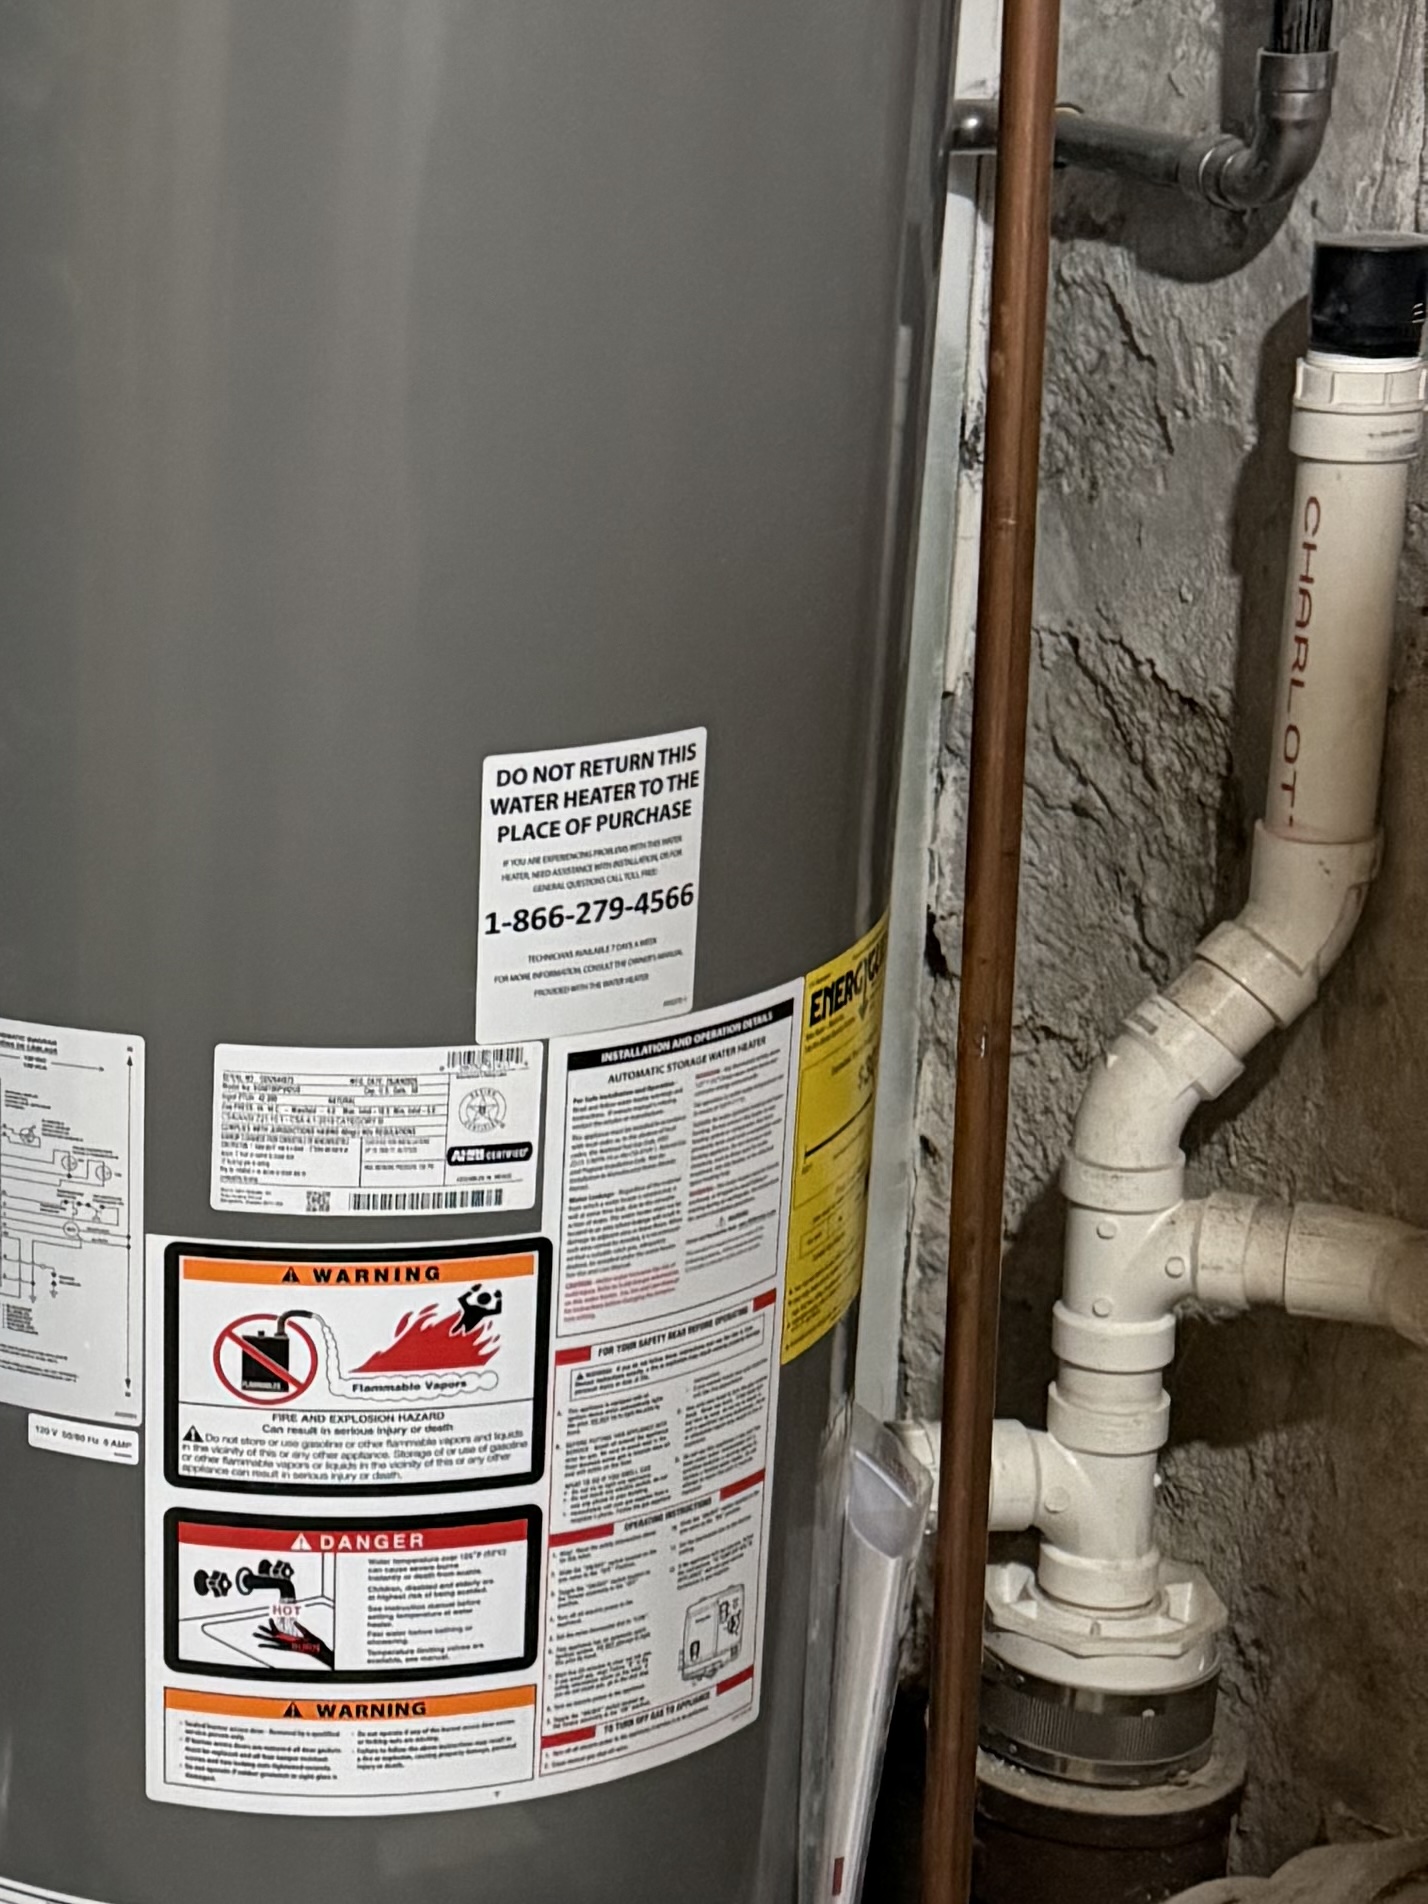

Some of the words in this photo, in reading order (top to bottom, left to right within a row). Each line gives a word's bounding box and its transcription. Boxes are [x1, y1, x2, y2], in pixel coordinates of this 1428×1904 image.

[1279, 495, 1322, 828] CHARLOT
[496, 766, 527, 788] DO
[532, 762, 574, 784] NOT
[579, 750, 654, 778] RETURN
[657, 742, 696, 765] THIS
[489, 789, 558, 818] WATER
[563, 781, 636, 808] HEATER
[638, 777, 663, 796] TO
[666, 770, 699, 792] THE
[497, 817, 560, 845] PLACE
[565, 815, 591, 836] OF
[596, 799, 691, 831] PURCHASE
[484, 882, 694, 938] 1-866-279-4566
[601, 1039, 670, 1063] INSTALLATION
[672, 1037, 692, 1051] AND
[694, 1021, 741, 1045] OPERATION
[608, 1065, 664, 1084] AUTOMATIC
[667, 1055, 707, 1074] STORAGE
[709, 1046, 736, 1062] WATER
[738, 1036, 766, 1055] HEATER
[314, 1266, 440, 1283] WARNING
[352, 1381, 420, 1393] Flammable
[426, 1379, 467, 1392] Vapors
[262, 1424, 283, 1433] Can
[287, 1426, 318, 1435] result
[321, 1426, 331, 1435] in
[334, 1426, 375, 1435] serious
[378, 1425, 408, 1437] injury
[425, 1422, 453, 1432] death
[273, 1413, 298, 1422] FIRE
[301, 1413, 326, 1422] AND
[330, 1413, 395, 1423] EXPLOSION
[399, 1411, 445, 1422] HAZARD
[321, 1533, 423, 1550] DANGER
[273, 1604, 301, 1616] HOT
[317, 1702, 426, 1719] WARNING
